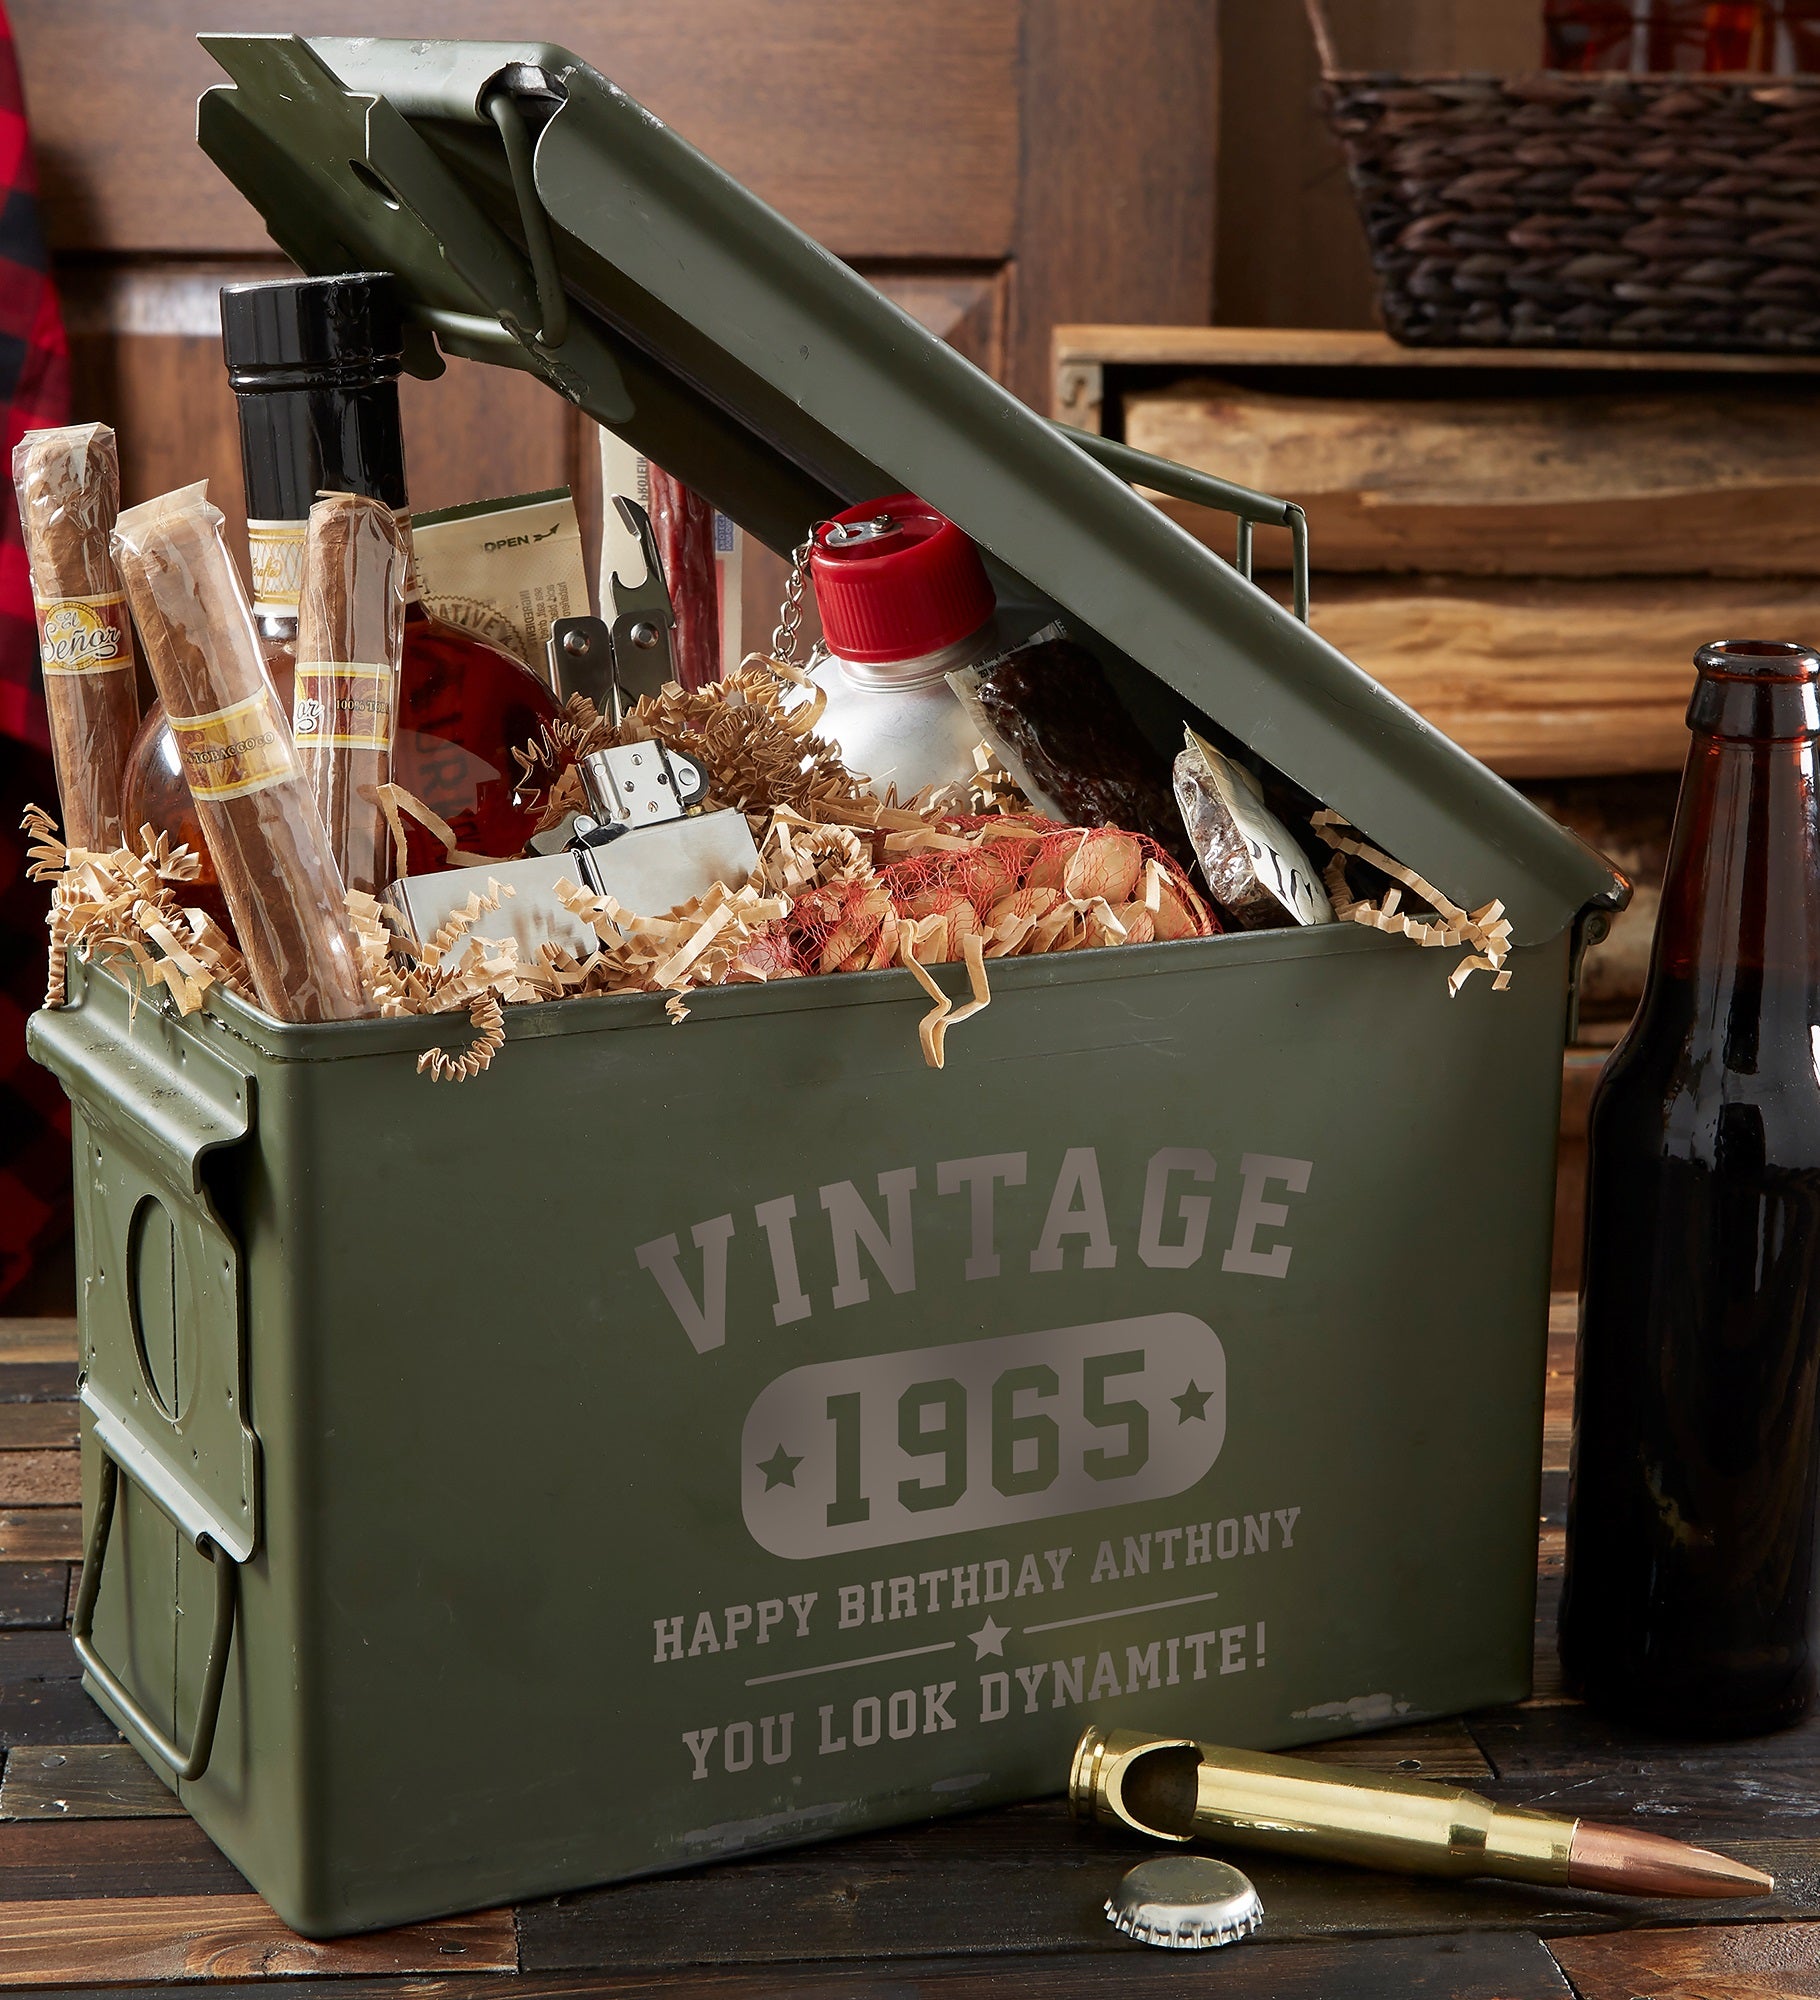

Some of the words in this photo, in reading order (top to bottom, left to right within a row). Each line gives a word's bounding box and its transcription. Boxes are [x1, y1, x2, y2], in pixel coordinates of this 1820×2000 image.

[484, 535, 530, 551] OPEN
[43, 622, 120, 663] Señor
[56, 611, 80, 630] El
[336, 698, 365, 711] 100%
[634, 1147, 1314, 1355] VINTAGE
[826, 1349, 1149, 1527] 1965
[654, 1592, 818, 1663] HAPPY
[838, 1547, 1072, 1630] BIRTHDAY
[1090, 1506, 1301, 1583] ANTHONY
[682, 1711, 795, 1780] YOU
[818, 1681, 957, 1755] LOOK
[979, 1620, 1266, 1723] DYNAMITE!
